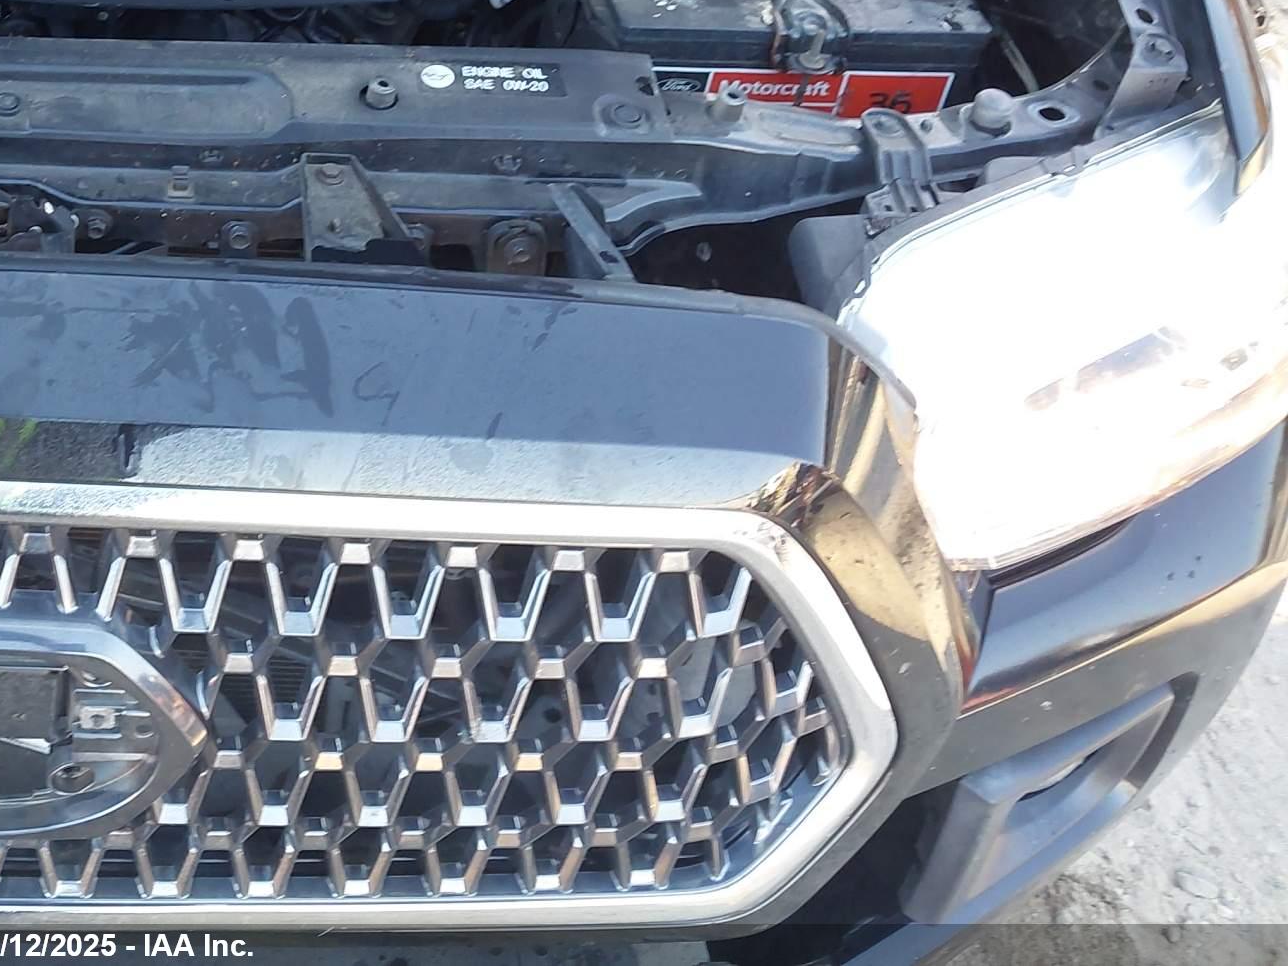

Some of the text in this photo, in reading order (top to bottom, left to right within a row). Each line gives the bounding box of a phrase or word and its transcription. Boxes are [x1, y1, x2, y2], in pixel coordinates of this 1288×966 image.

[461, 66, 548, 80] ENGINE OIL
[463, 78, 550, 92] SAE 0W-20
